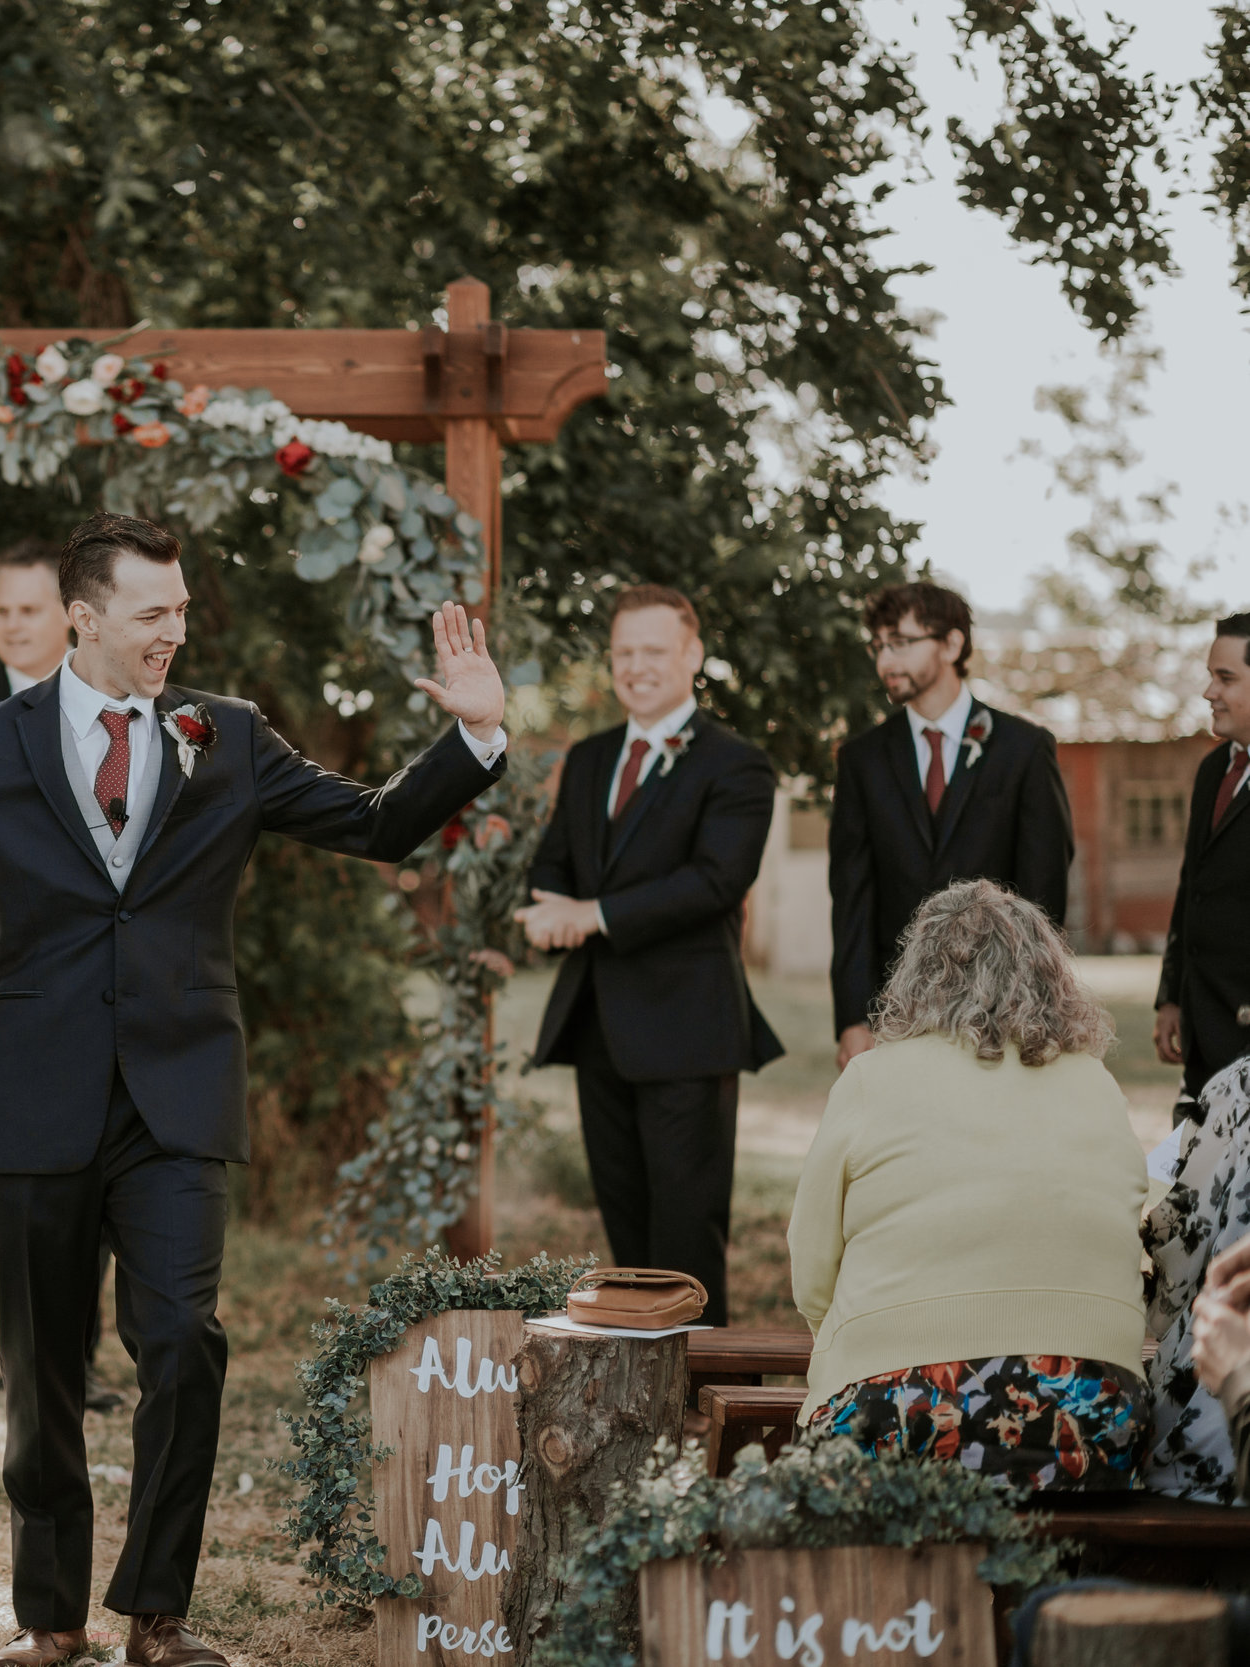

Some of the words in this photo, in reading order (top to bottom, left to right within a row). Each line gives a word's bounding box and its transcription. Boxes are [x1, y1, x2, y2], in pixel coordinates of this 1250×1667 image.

[706, 1599, 760, 1661] It
[775, 1596, 824, 1667] is
[840, 1598, 945, 1658] not
